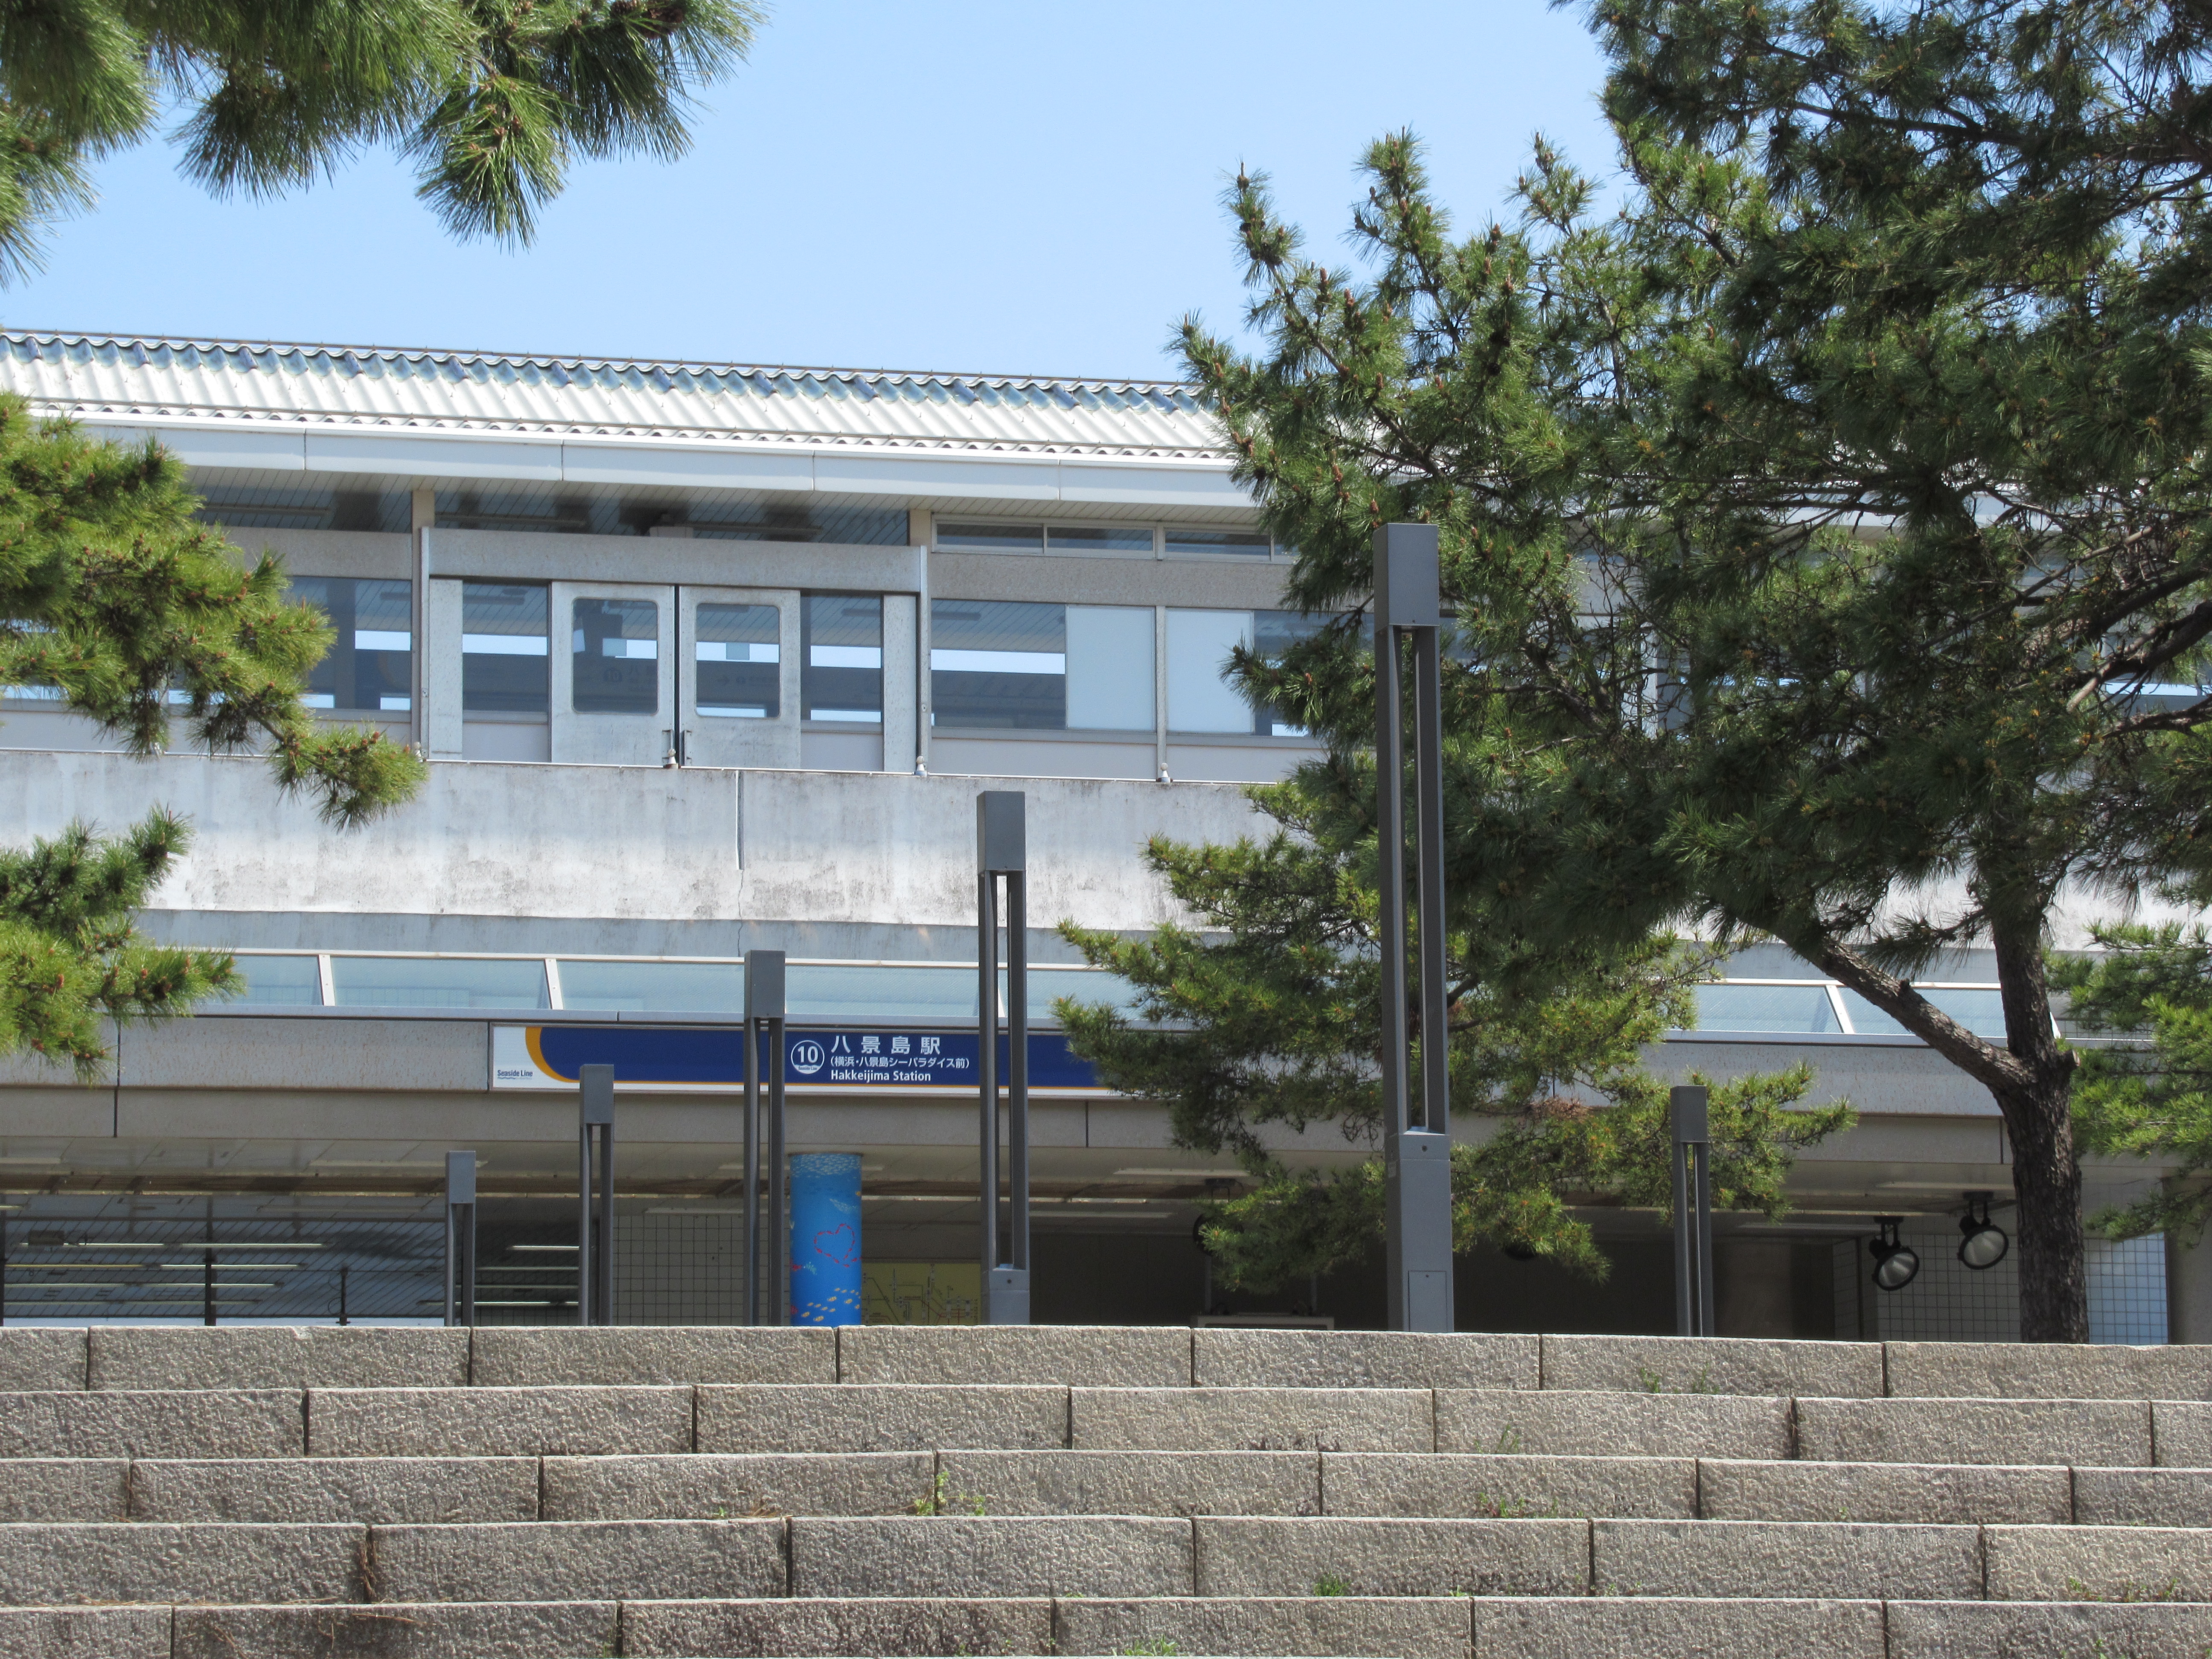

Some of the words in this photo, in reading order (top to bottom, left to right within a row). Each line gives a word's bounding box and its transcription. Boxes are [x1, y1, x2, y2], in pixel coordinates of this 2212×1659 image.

[797, 1045, 818, 1063] 10
[831, 1035, 940, 1055] 八景島駅
[831, 1069, 890, 1083] Hakkeijima
[893, 1070, 931, 1081] Station
